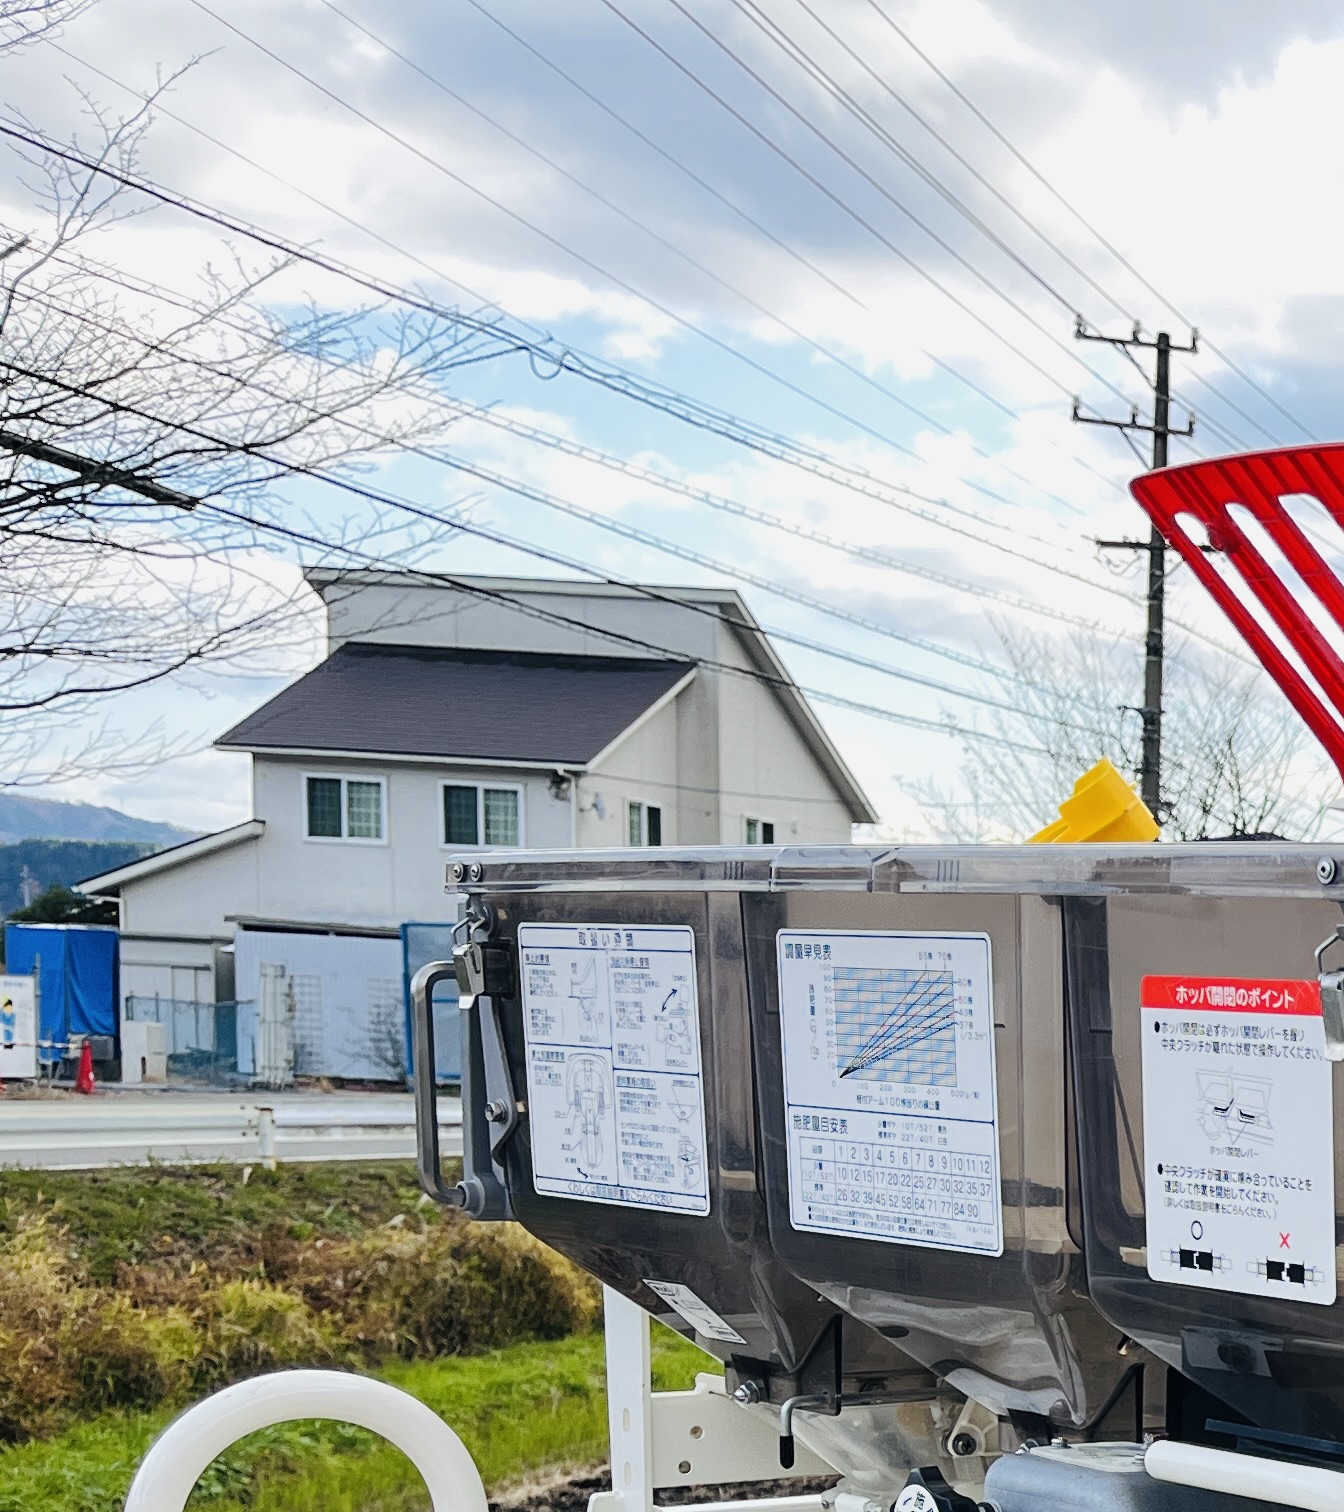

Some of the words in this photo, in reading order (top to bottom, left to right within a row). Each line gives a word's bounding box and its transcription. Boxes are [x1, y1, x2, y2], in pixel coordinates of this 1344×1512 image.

[1175, 984, 1295, 1009] ホッパ開閉のポイント
[838, 1145, 843, 1158] 1
[850, 1146, 857, 1160] 2
[863, 1147, 869, 1161] 3
[876, 1149, 882, 1162] 4
[888, 1150, 895, 1164] 5
[902, 1151, 908, 1165] 6
[915, 1152, 921, 1166] 7
[927, 1154, 935, 1168] 8
[940, 1155, 947, 1169] 9
[951, 1156, 963, 1171] 10
[965, 1157, 976, 1172] 11
[979, 1159, 990, 1174] 12
[837, 1166, 847, 1181] 10
[849, 1168, 860, 1182] 12
[862, 1169, 873, 1184] 15
[875, 1171, 885, 1185] 17
[887, 1172, 898, 1187] 20
[900, 1173, 911, 1188] 22
[913, 1175, 924, 1190] 25
[926, 1176, 937, 1191] 27
[939, 1178, 950, 1193] 30
[952, 1179, 964, 1194] 32
[966, 1180, 978, 1196] 35
[979, 1182, 991, 1197] 37
[837, 1187, 848, 1202] 26
[849, 1189, 860, 1204] 32
[862, 1190, 873, 1205] 39
[875, 1192, 886, 1207] 45
[888, 1193, 899, 1208] 52
[901, 1195, 912, 1210] 58
[914, 1196, 925, 1211] 64
[927, 1198, 937, 1213] 71
[940, 1199, 951, 1215] 77
[953, 1201, 964, 1216] 84
[966, 1203, 978, 1218] 90
